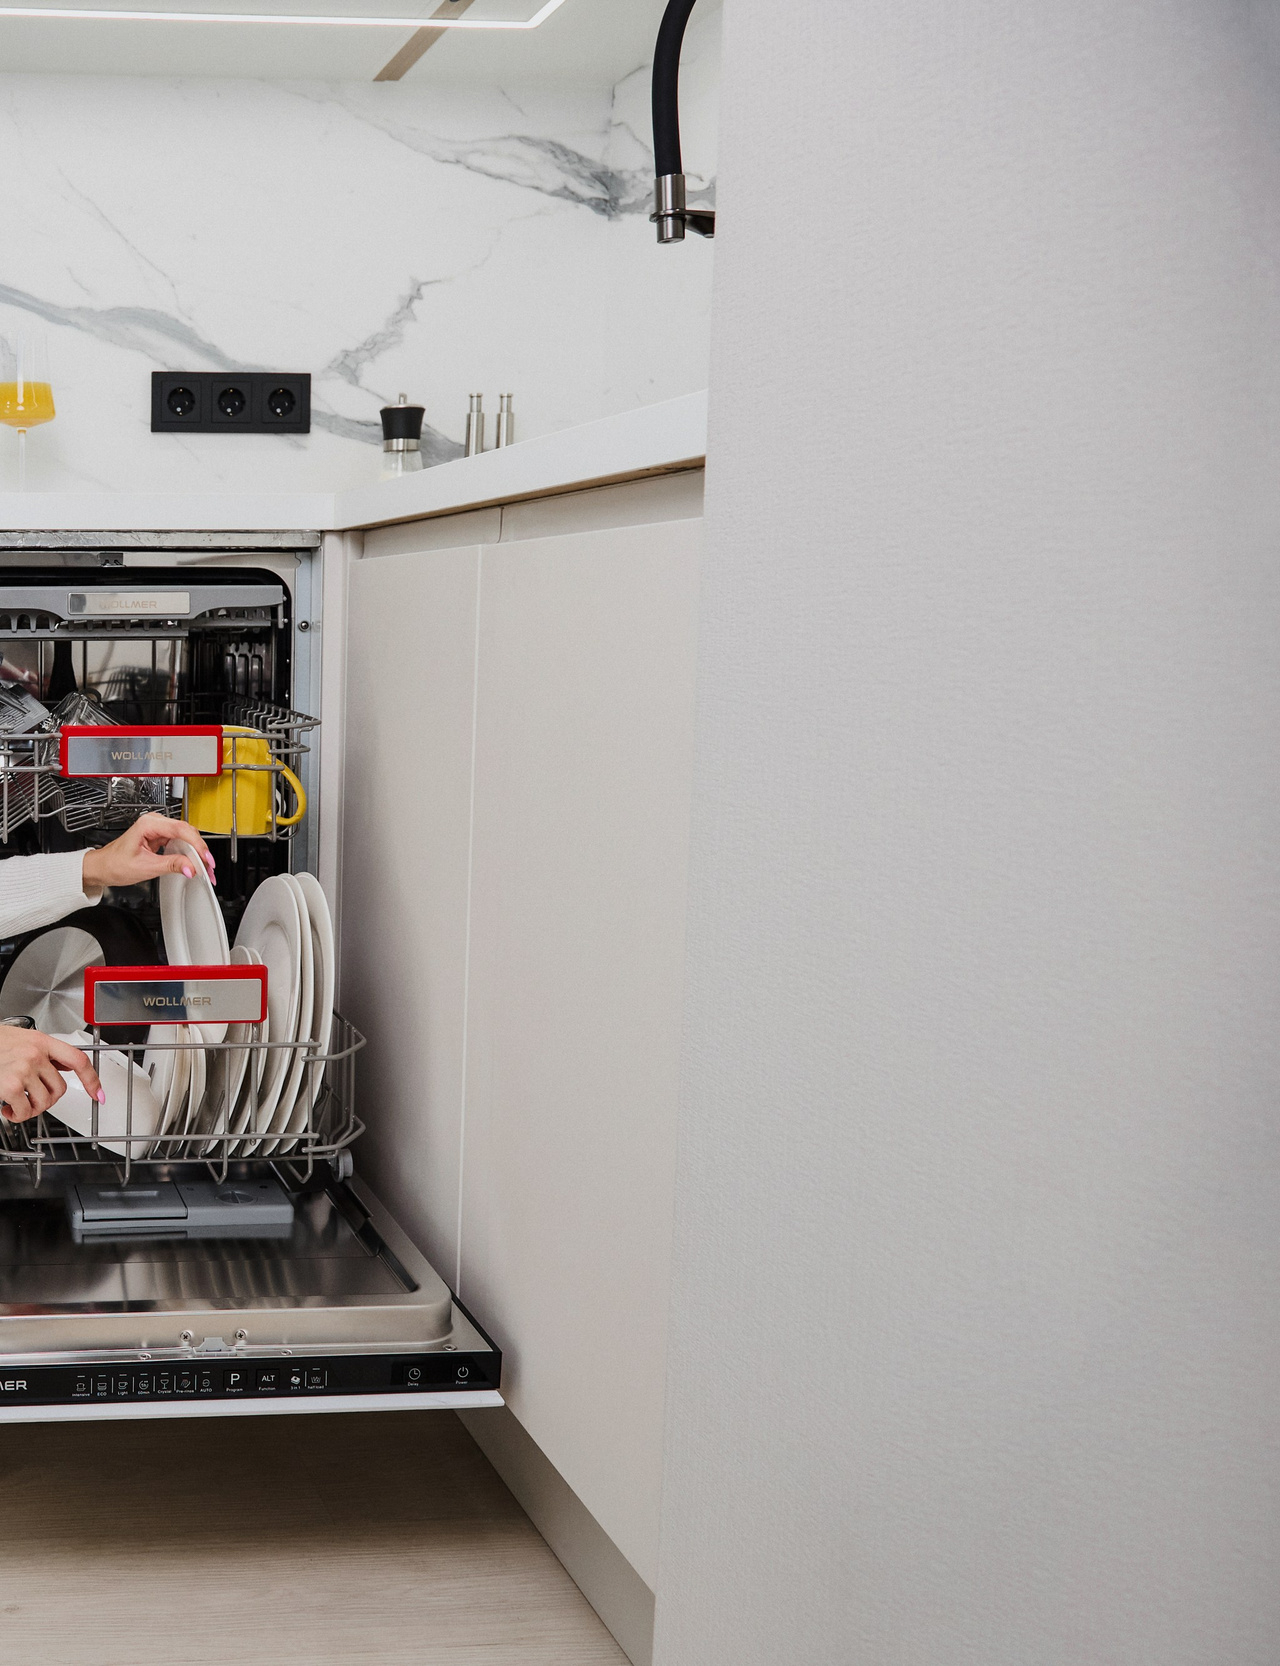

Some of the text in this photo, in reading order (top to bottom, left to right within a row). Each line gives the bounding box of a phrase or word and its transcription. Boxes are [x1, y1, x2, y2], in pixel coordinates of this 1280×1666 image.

[111, 751, 173, 760] WOLLMER
[142, 996, 212, 1007] WOLLMER
[230, 1373, 241, 1385] P
